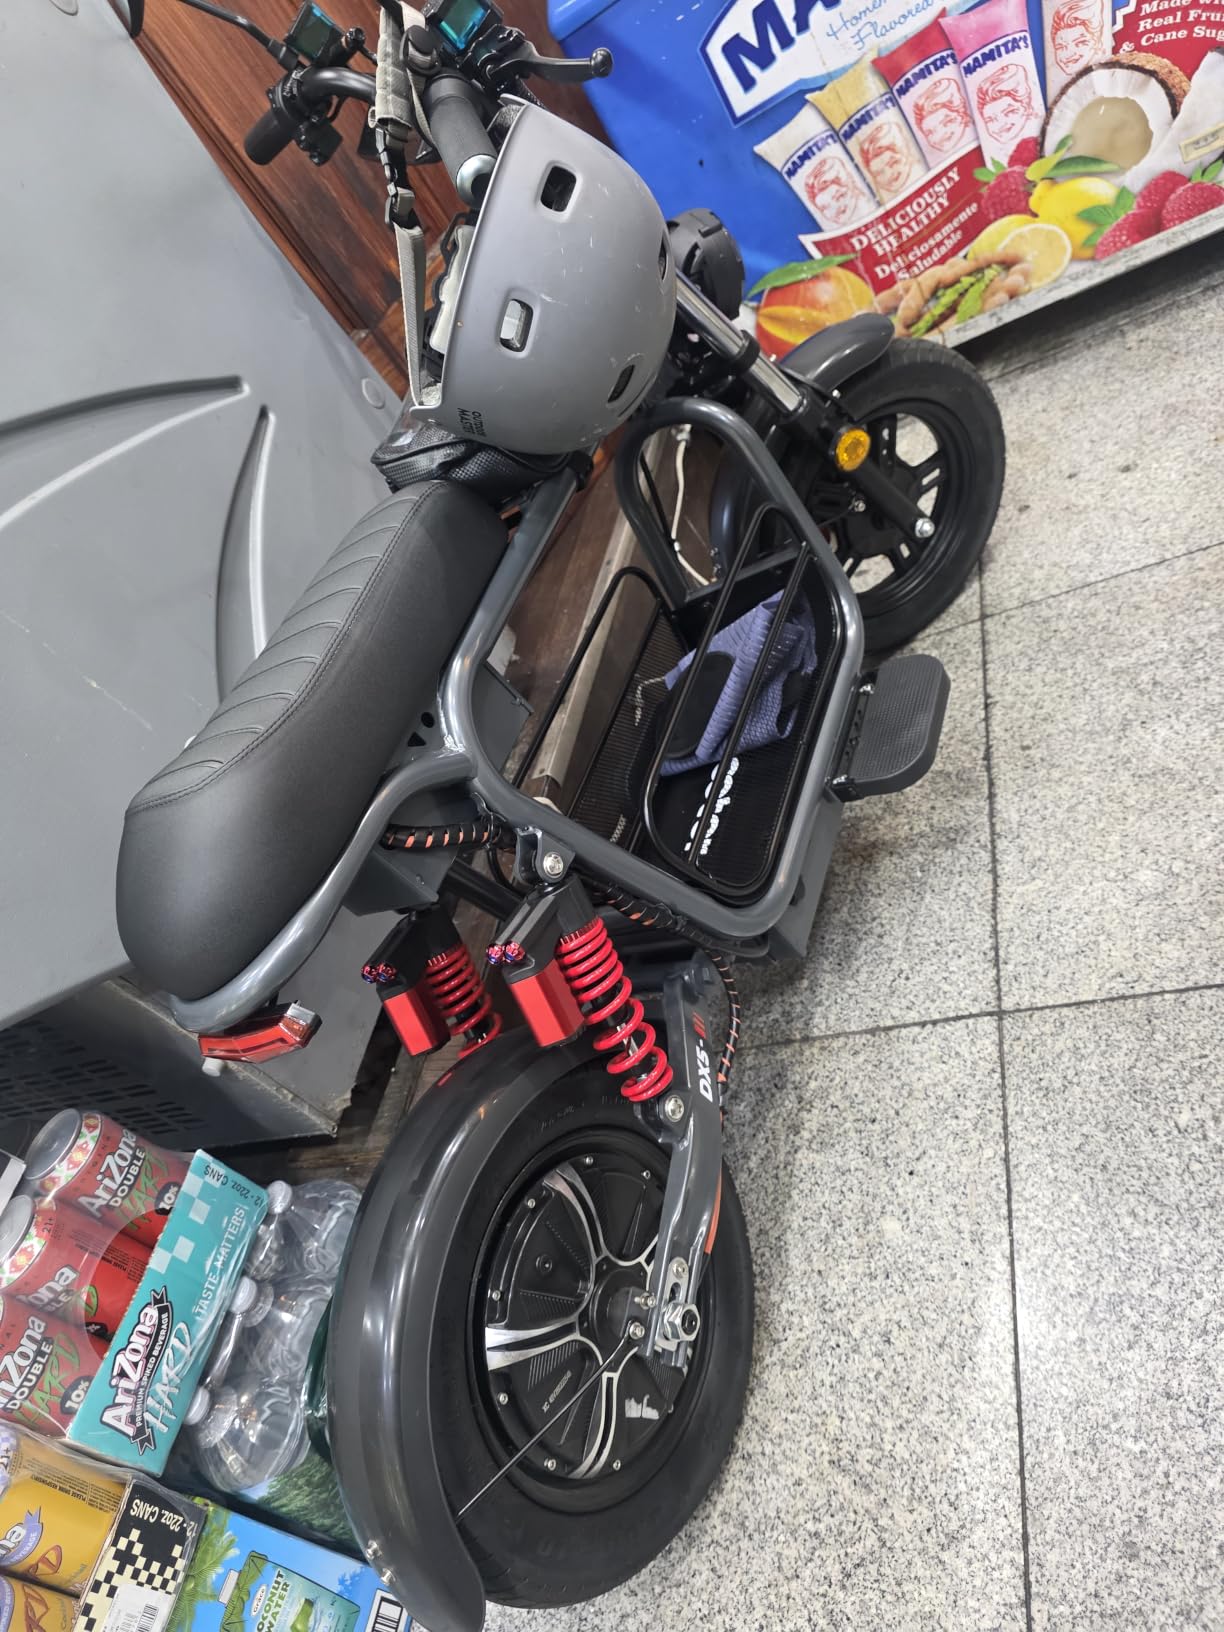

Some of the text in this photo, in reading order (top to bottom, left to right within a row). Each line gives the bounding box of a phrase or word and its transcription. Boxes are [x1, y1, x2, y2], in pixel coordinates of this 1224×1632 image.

[1119, 25, 1224, 53] & Cane Sug
[1137, 11, 1182, 32] Real
[850, 166, 961, 251] DELICIOUSLY
[873, 193, 949, 257] HEALTHY
[874, 202, 979, 280] Deliciosamente
[897, 230, 963, 281] Saludable
[78, 1128, 137, 1218] AriZona
[109, 1148, 146, 1209] DOUBLE
[203, 1164, 229, 1186] CANS
[195, 1206, 246, 1321] TASTE MATTERS
[6, 1340, 53, 1411] DOUBLE
[65, 1379, 90, 1412] 10%
[101, 1306, 159, 1438] AriZona
[135, 1311, 170, 1427] PREMIUM SPIKED BEVERAGE
[142, 1321, 192, 1434] HARD
[129, 1498, 159, 1523] CANS
[256, 1570, 285, 1632] OCONUT
